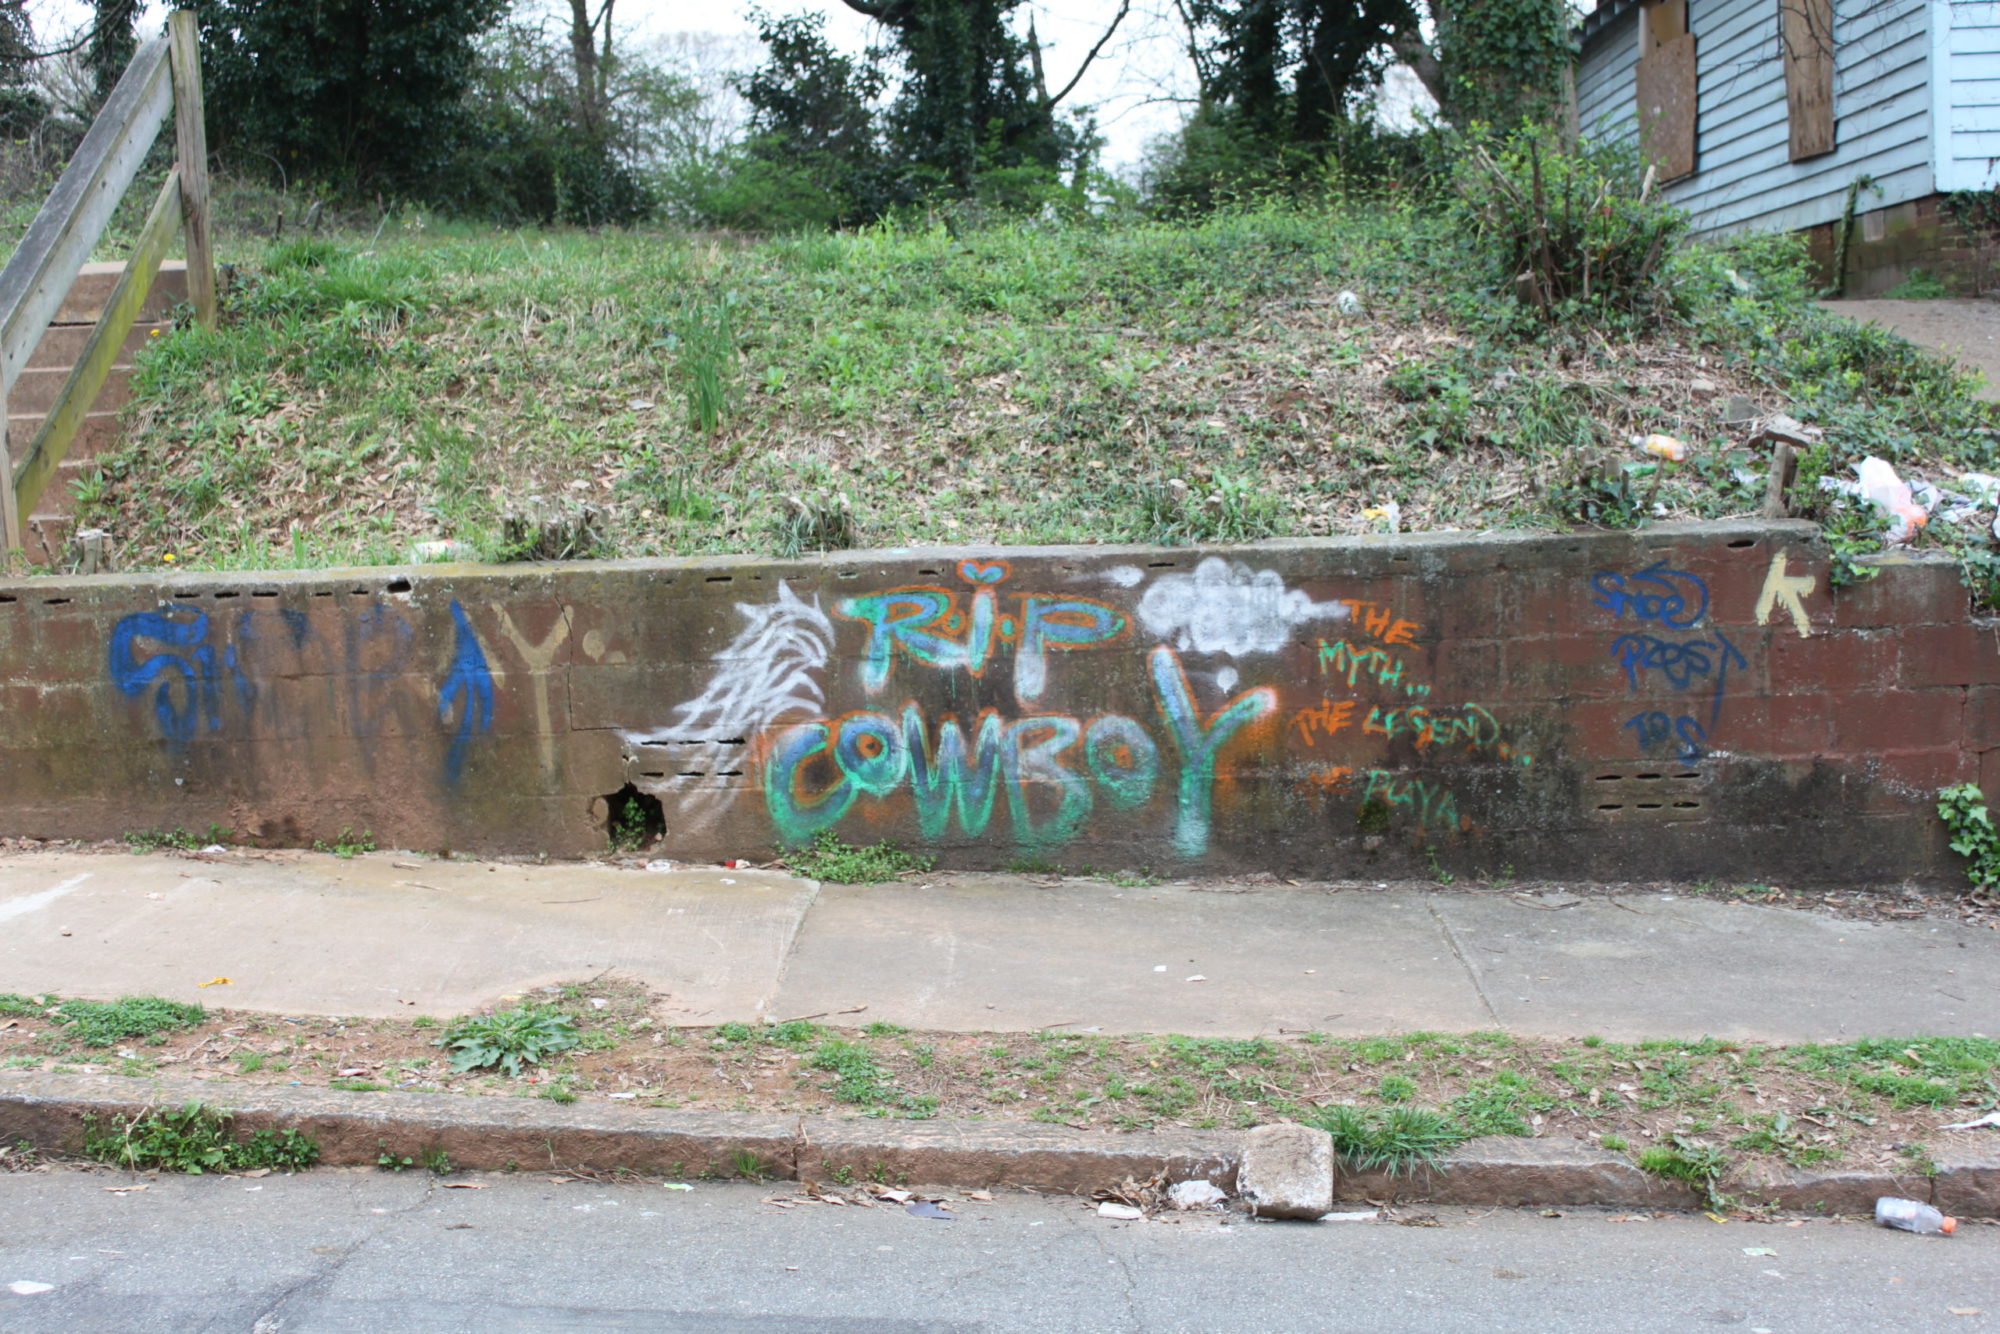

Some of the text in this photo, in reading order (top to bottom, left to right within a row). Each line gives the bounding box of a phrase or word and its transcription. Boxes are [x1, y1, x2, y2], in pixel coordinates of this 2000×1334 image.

[1339, 599, 1421, 650] THE
[1284, 698, 1356, 747] THE
[758, 643, 1279, 860] COWBOY
